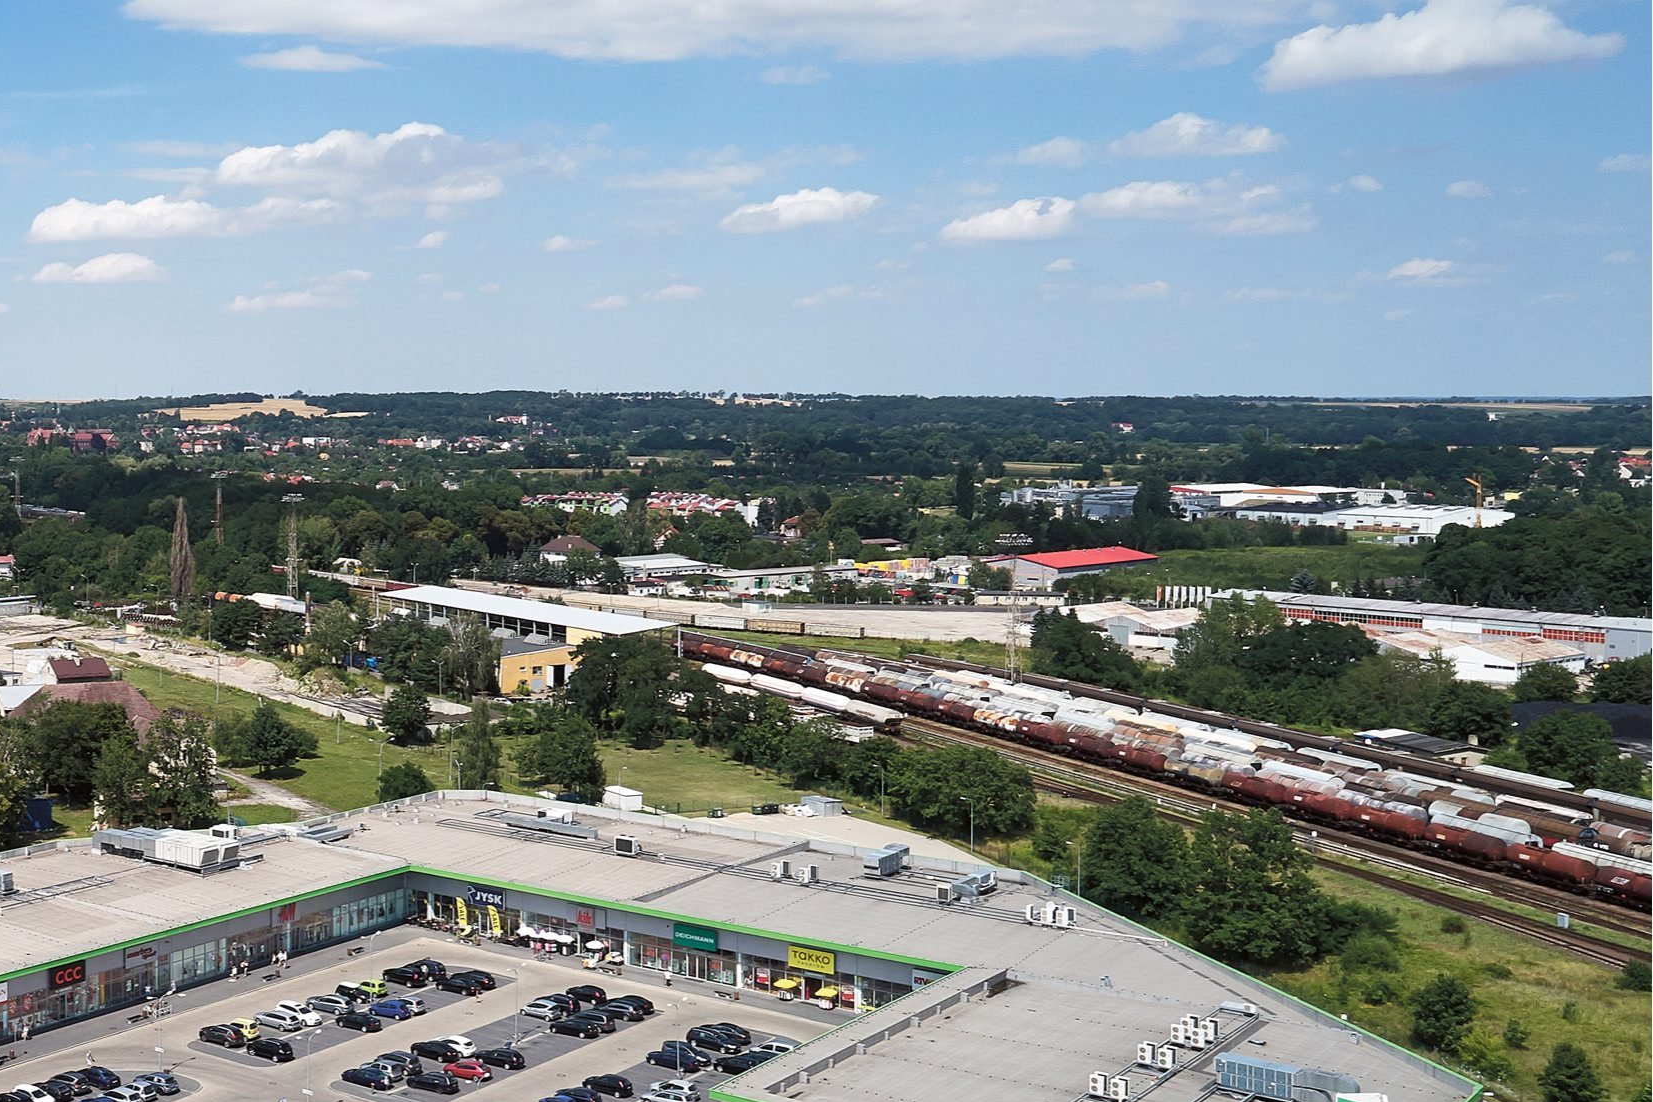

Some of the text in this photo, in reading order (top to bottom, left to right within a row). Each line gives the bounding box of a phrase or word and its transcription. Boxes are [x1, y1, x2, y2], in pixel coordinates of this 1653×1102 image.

[475, 891, 503, 905] JYSK
[674, 931, 715, 944] DEICHMANN
[54, 965, 83, 986] CCC
